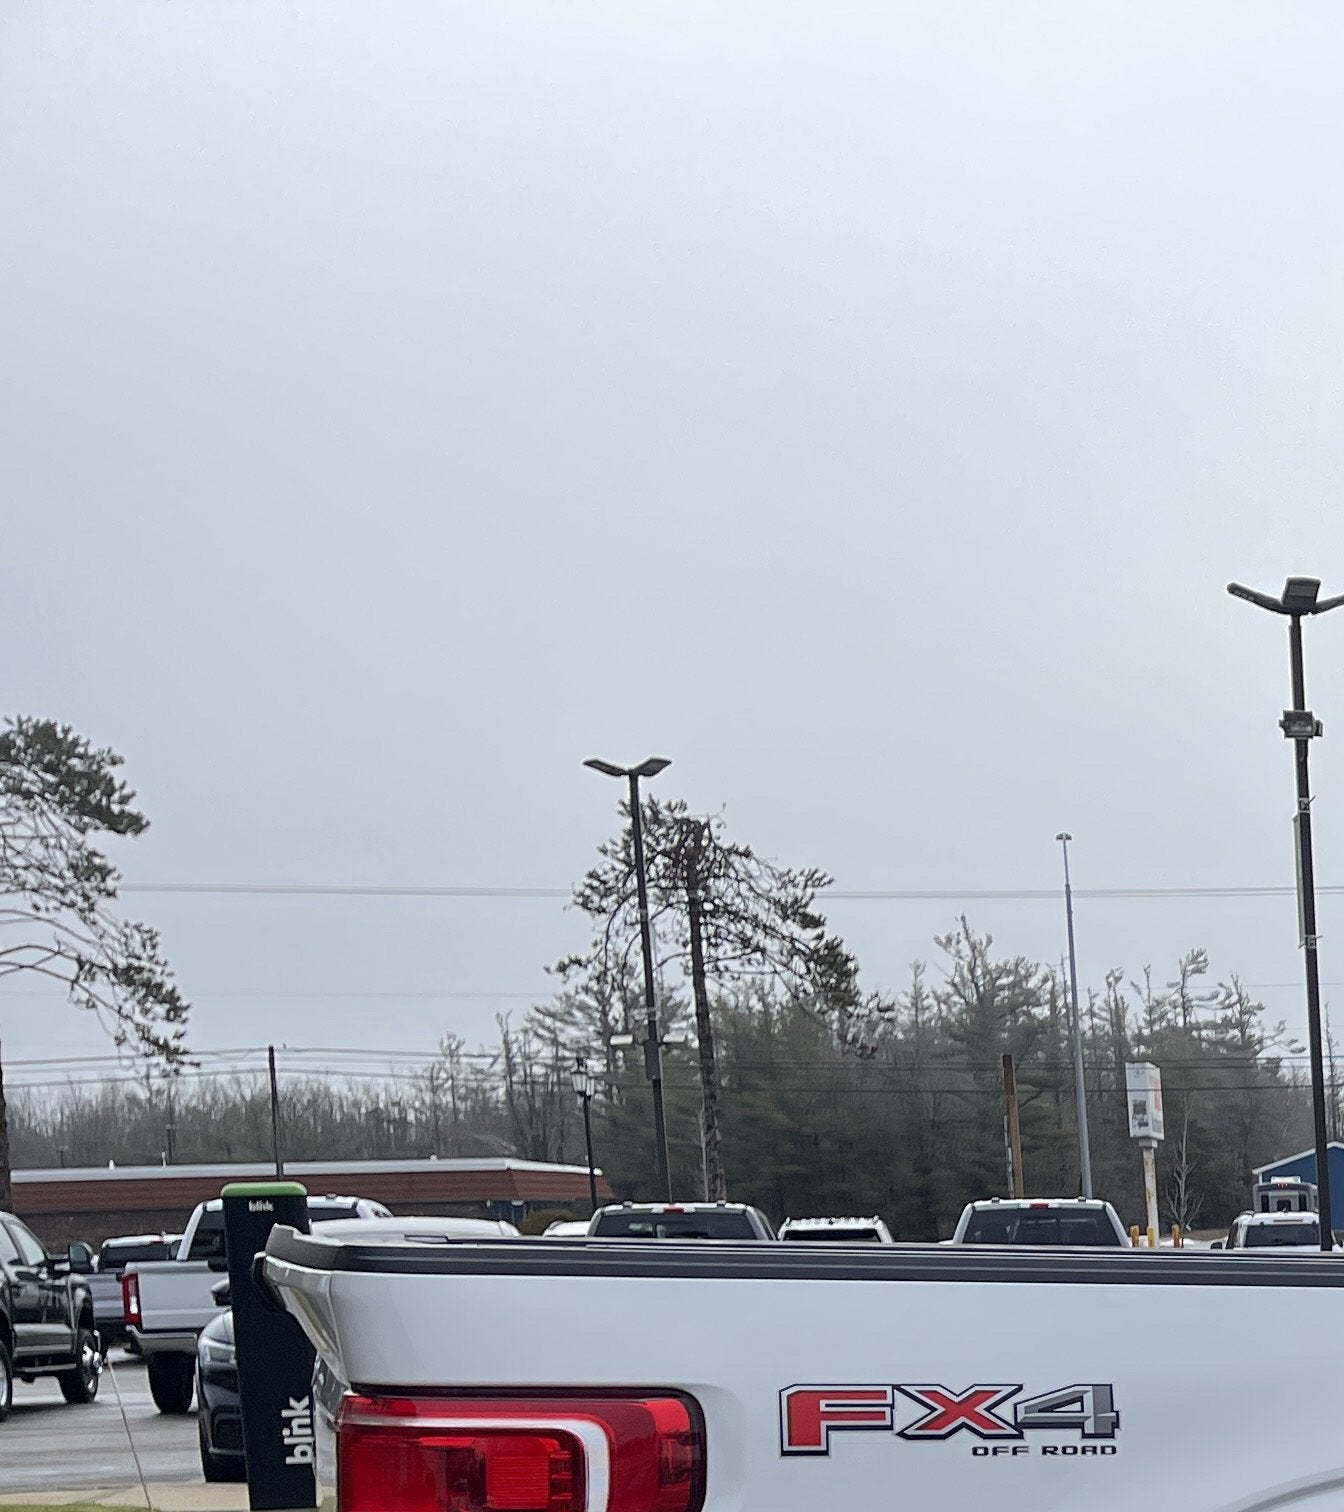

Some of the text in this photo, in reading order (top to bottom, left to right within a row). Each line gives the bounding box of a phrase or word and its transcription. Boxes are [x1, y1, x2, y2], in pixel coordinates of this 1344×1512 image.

[248, 1199, 274, 1212] blink
[281, 1394, 315, 1465] blink
[779, 1383, 1119, 1457] FX4
[971, 1444, 1118, 1456] OFF ROAD
